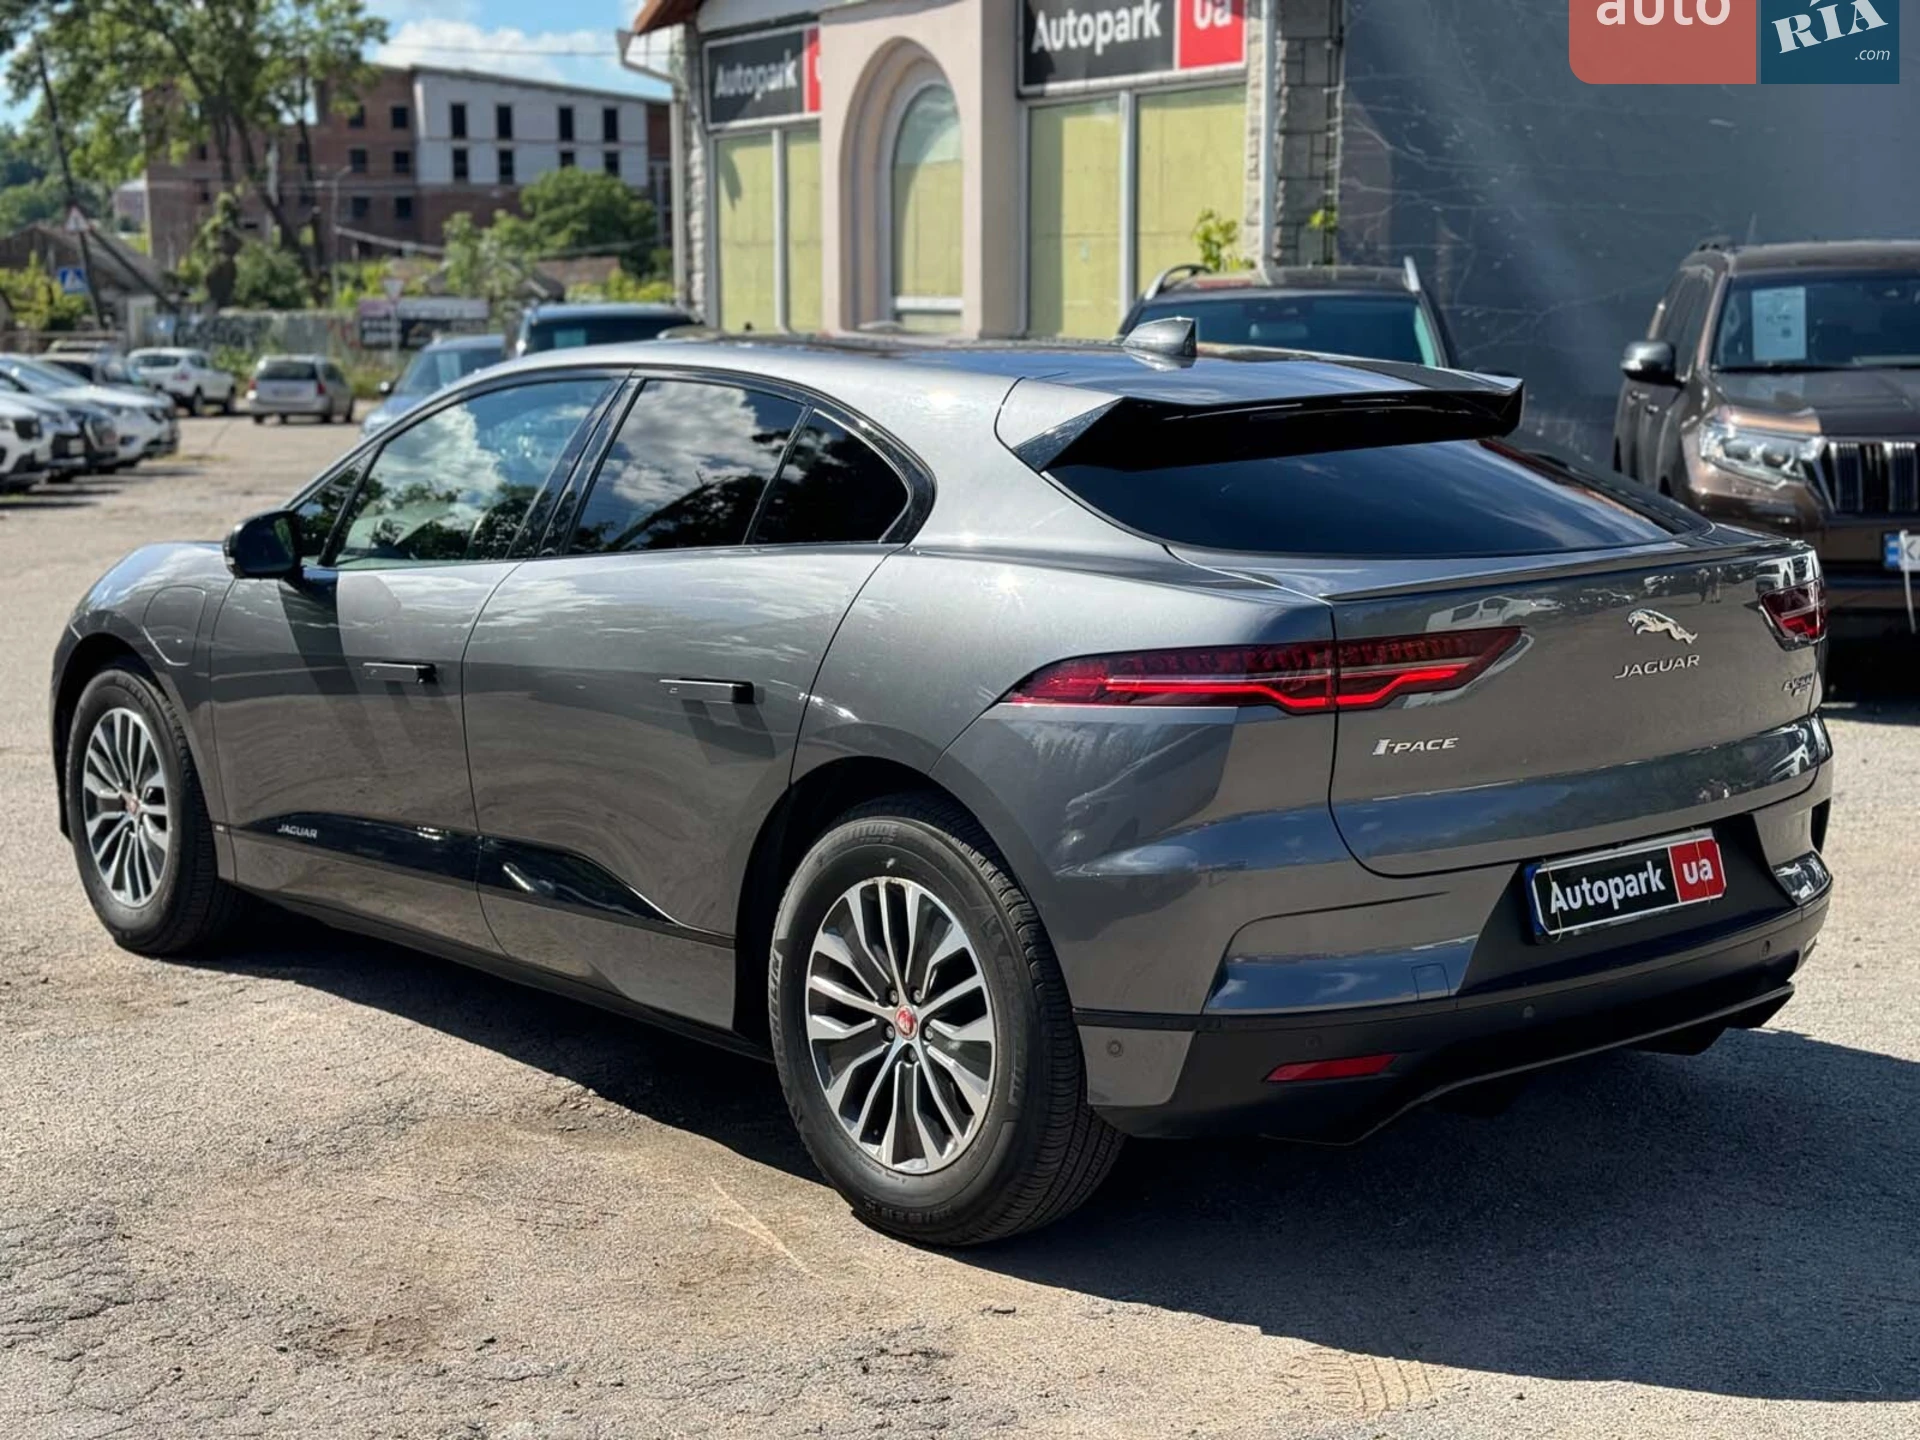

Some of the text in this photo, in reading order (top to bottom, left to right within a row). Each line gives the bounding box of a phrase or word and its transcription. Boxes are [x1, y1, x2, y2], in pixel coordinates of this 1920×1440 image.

[1031, 0, 1162, 56] Autopark
[714, 48, 798, 100] Autopark
[1614, 654, 1700, 679] JAGUAR
[1372, 737, 1460, 755] I-PACE
[277, 824, 318, 839] JAGUAR
[1550, 857, 1714, 914] Autopark ua
